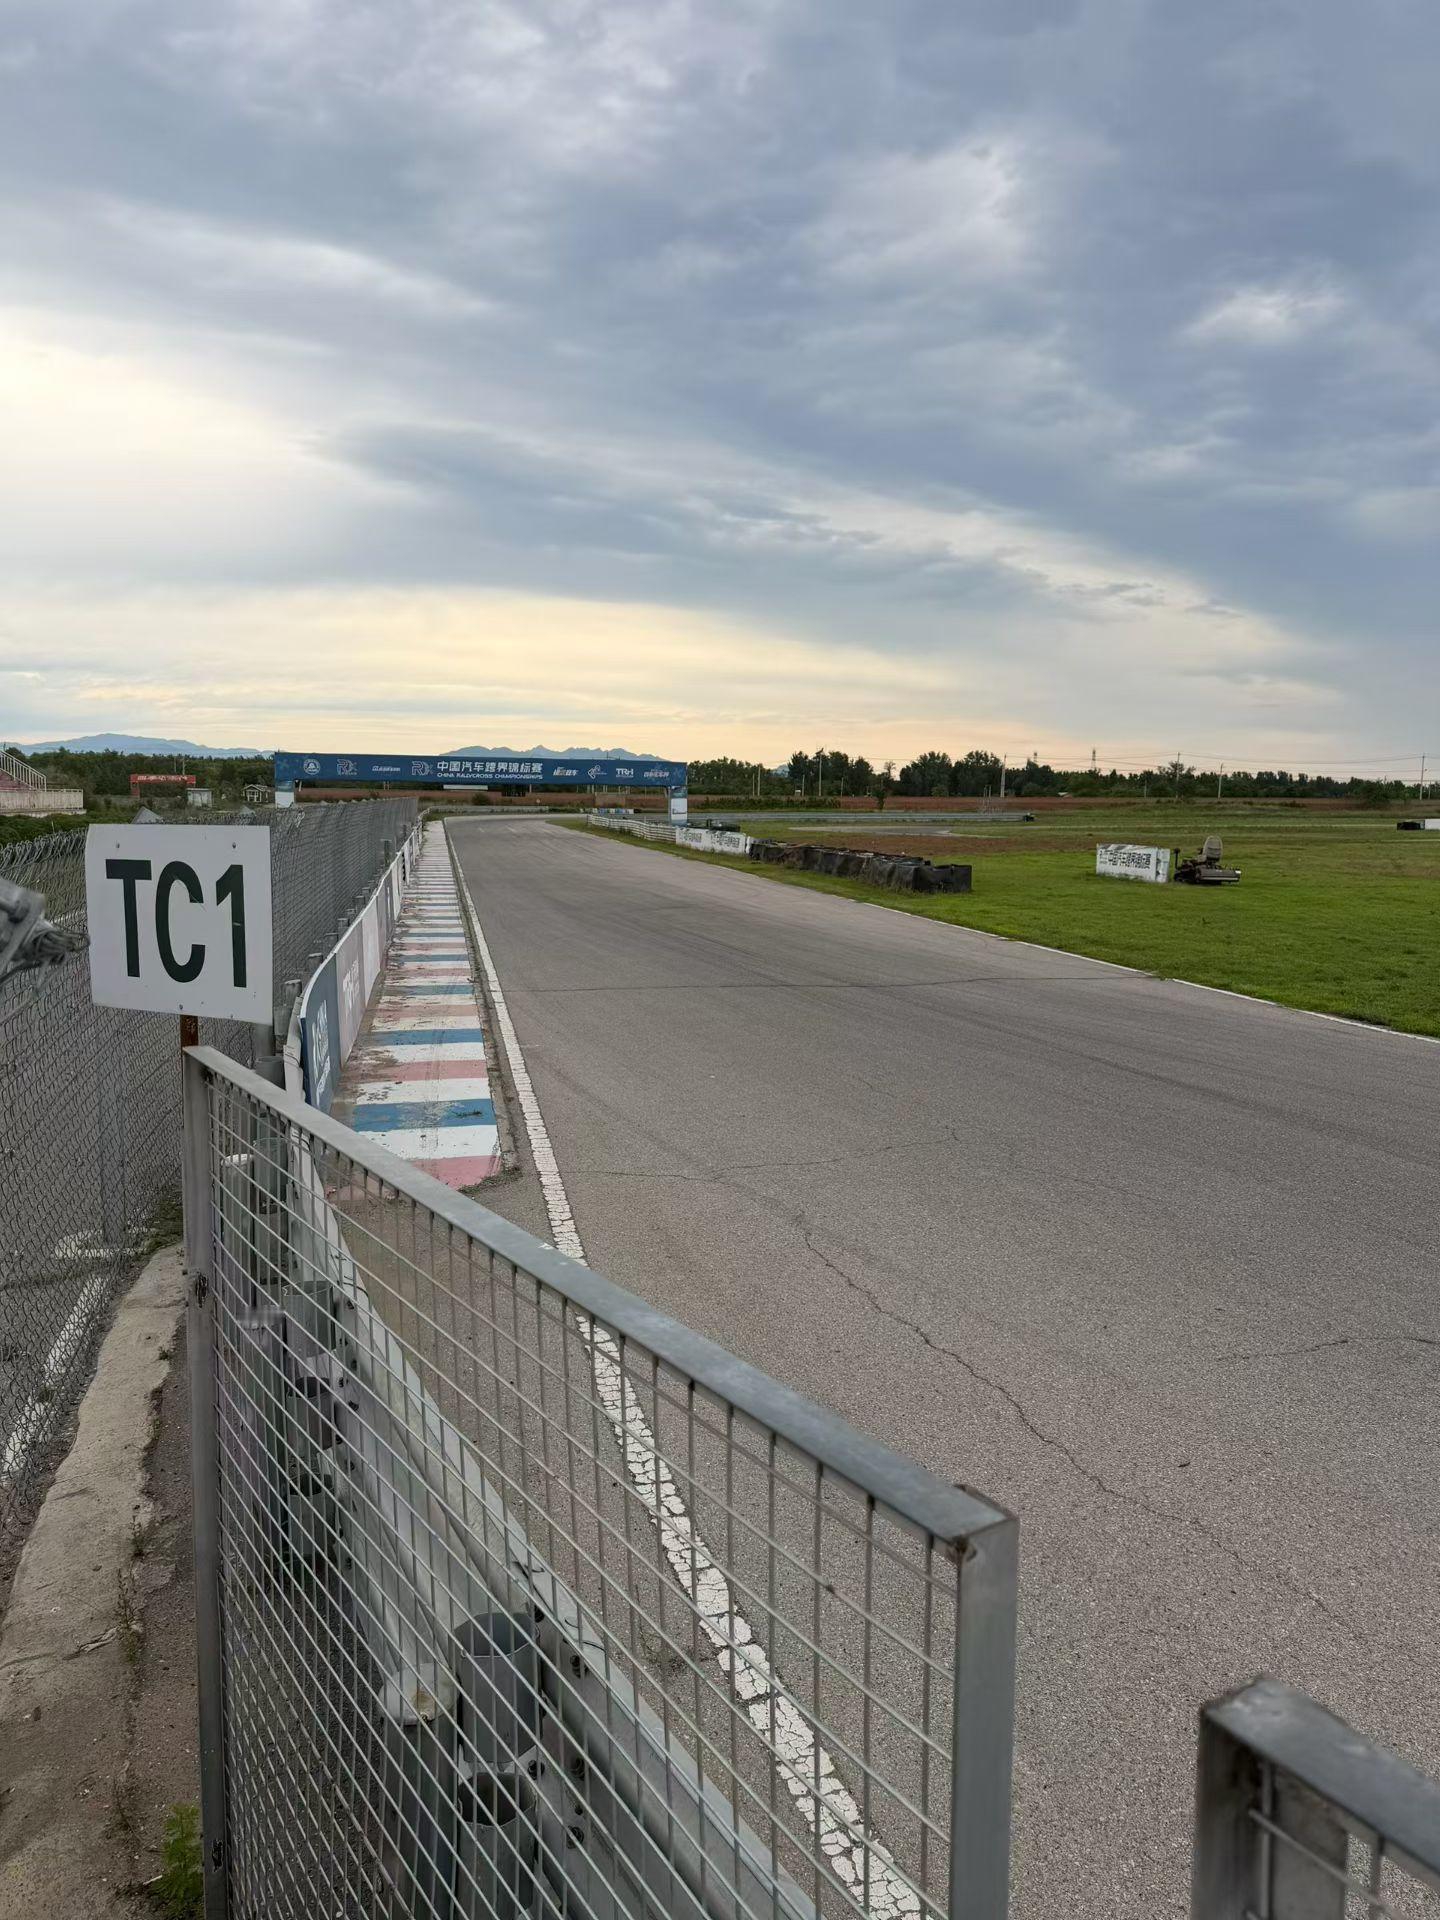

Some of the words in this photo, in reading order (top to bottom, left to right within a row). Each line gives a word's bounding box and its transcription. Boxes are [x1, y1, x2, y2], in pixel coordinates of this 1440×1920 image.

[437, 760, 543, 773] 中国汽车跨界锦标赛
[105, 858, 247, 988] TC1
